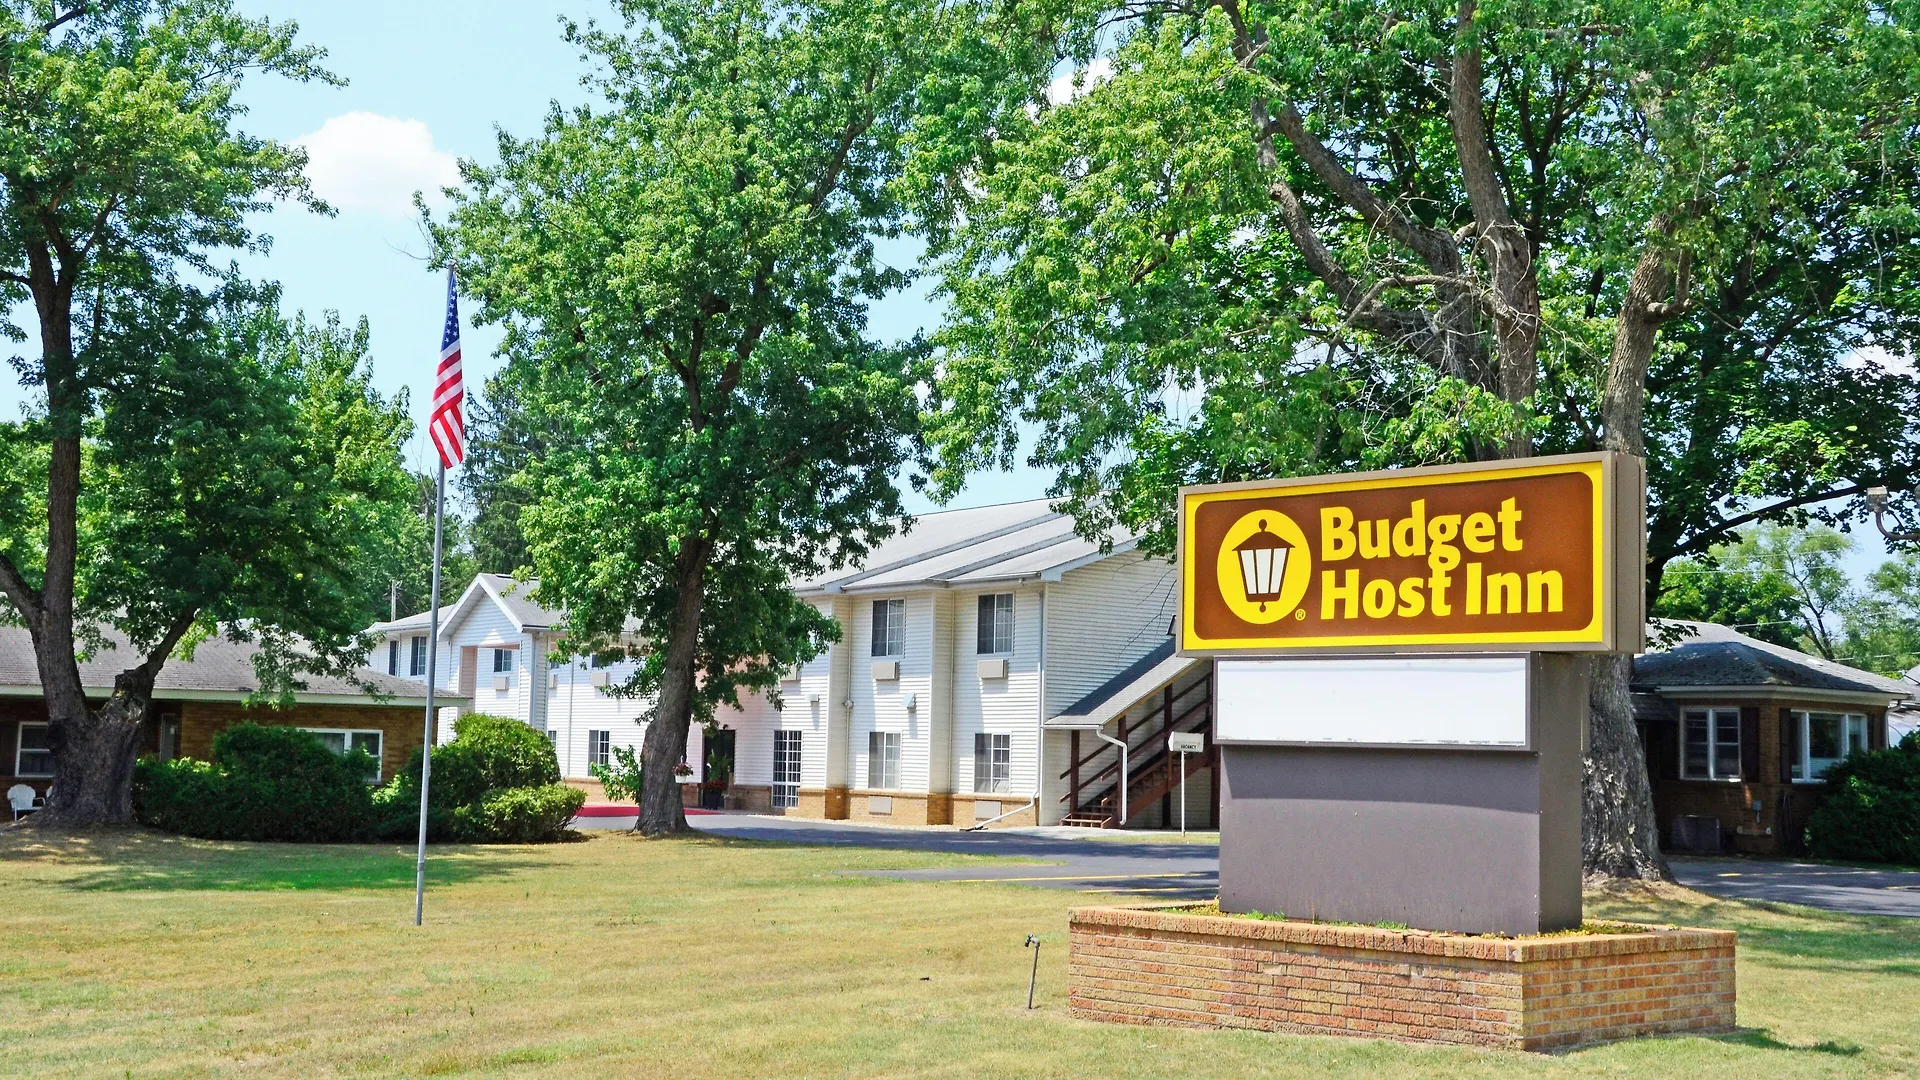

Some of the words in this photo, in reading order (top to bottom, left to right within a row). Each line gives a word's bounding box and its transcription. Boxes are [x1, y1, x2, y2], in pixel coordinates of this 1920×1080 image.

[1320, 497, 1523, 571] Budget
[1321, 566, 1452, 620] Host
[1465, 562, 1563, 615] Inn
